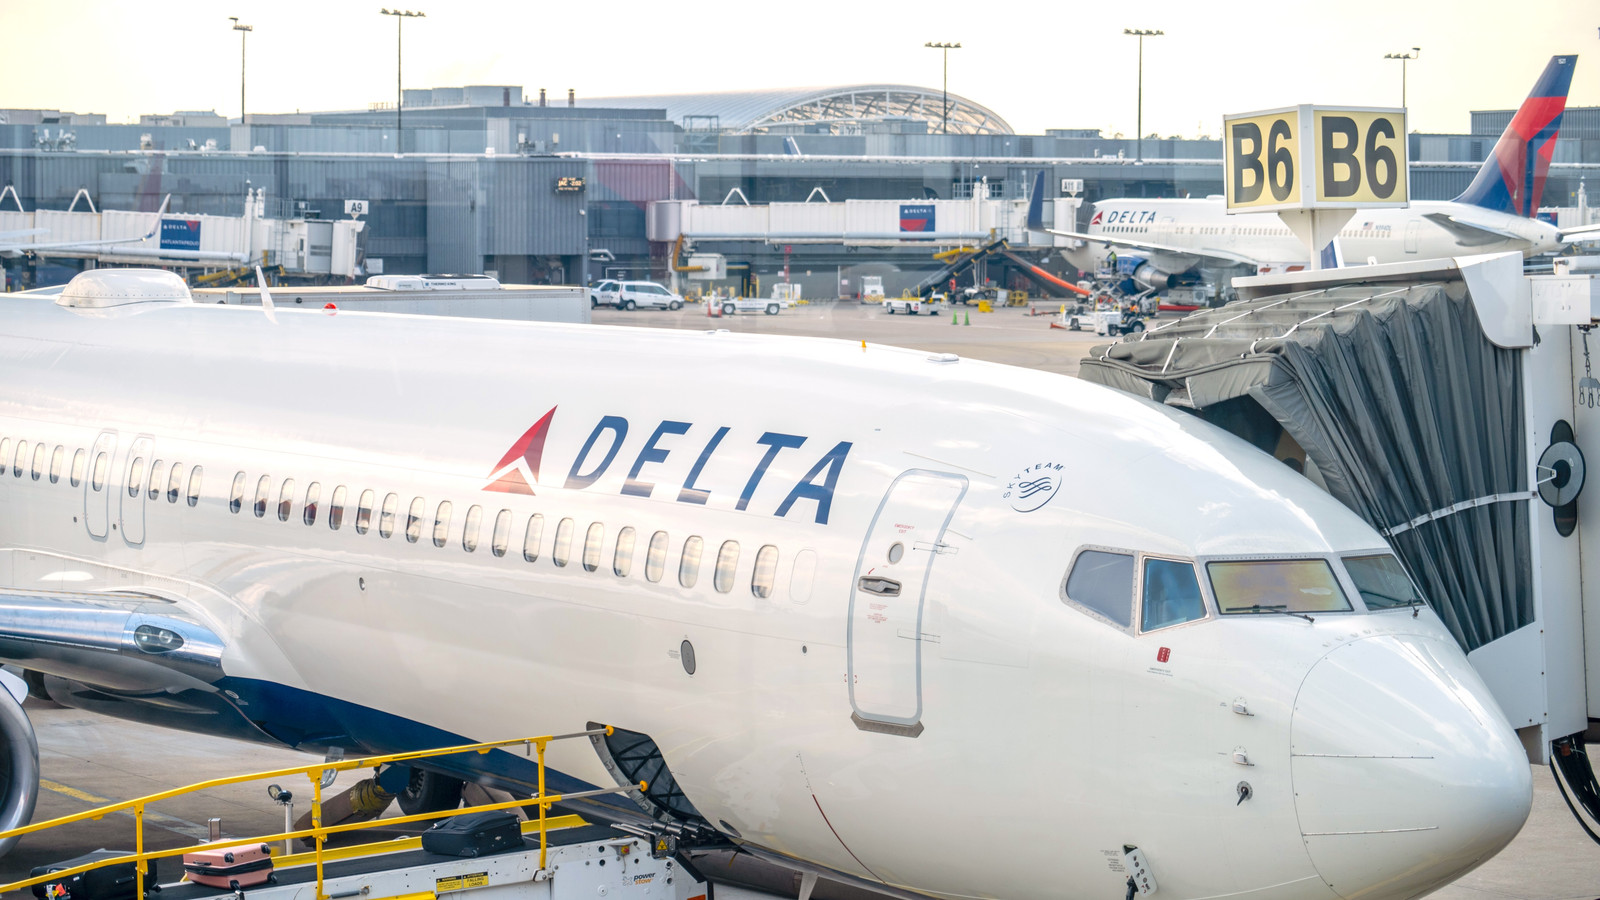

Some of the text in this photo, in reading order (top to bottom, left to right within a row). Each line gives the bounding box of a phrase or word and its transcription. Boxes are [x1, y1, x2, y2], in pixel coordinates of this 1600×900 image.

[1232, 119, 1294, 203] B6
[1321, 116, 1398, 199] B6
[350, 202, 363, 213] A9
[1107, 210, 1157, 224] DELTA
[562, 415, 854, 526] DELTA
[1002, 461, 1065, 499] SKYTEAM
[633, 872, 656, 882] power
[634, 878, 652, 886] stow
